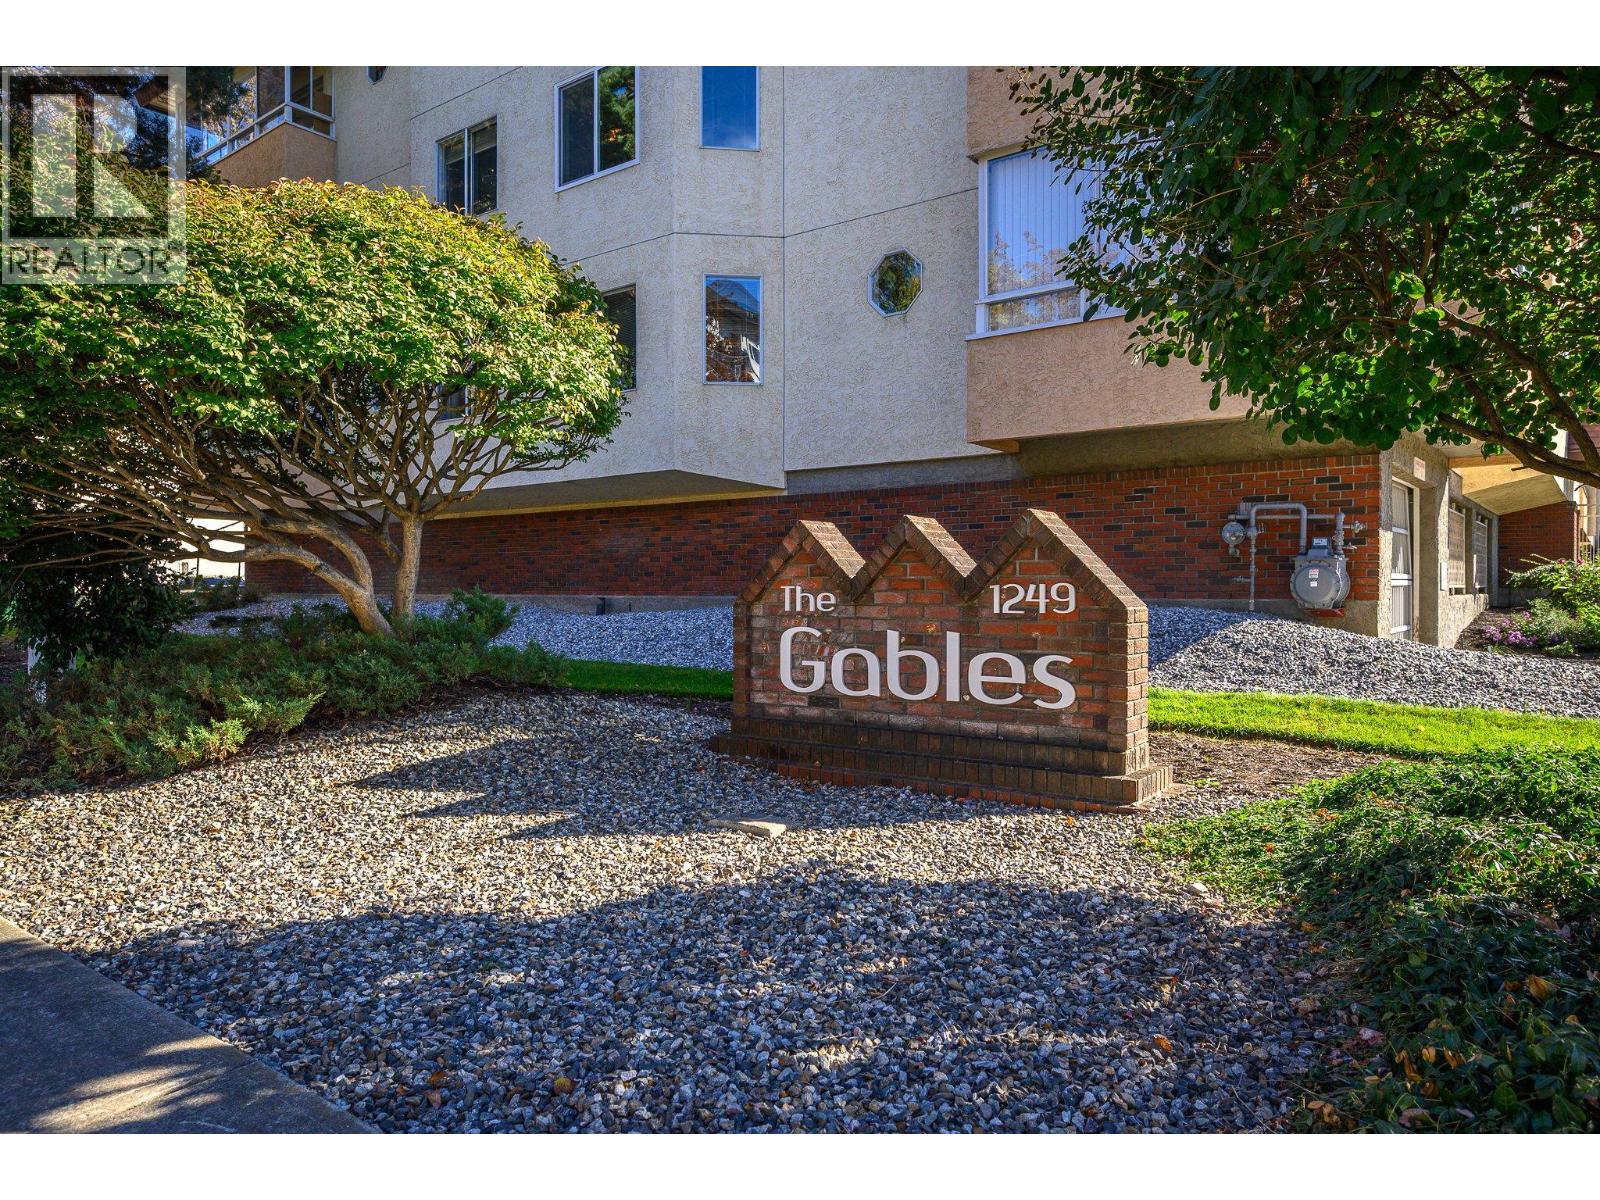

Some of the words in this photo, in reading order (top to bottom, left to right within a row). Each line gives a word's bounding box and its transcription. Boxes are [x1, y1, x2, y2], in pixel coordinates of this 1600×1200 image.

[780, 585, 836, 612] The
[989, 582, 1077, 614] 1249
[779, 626, 1077, 710] Gables
